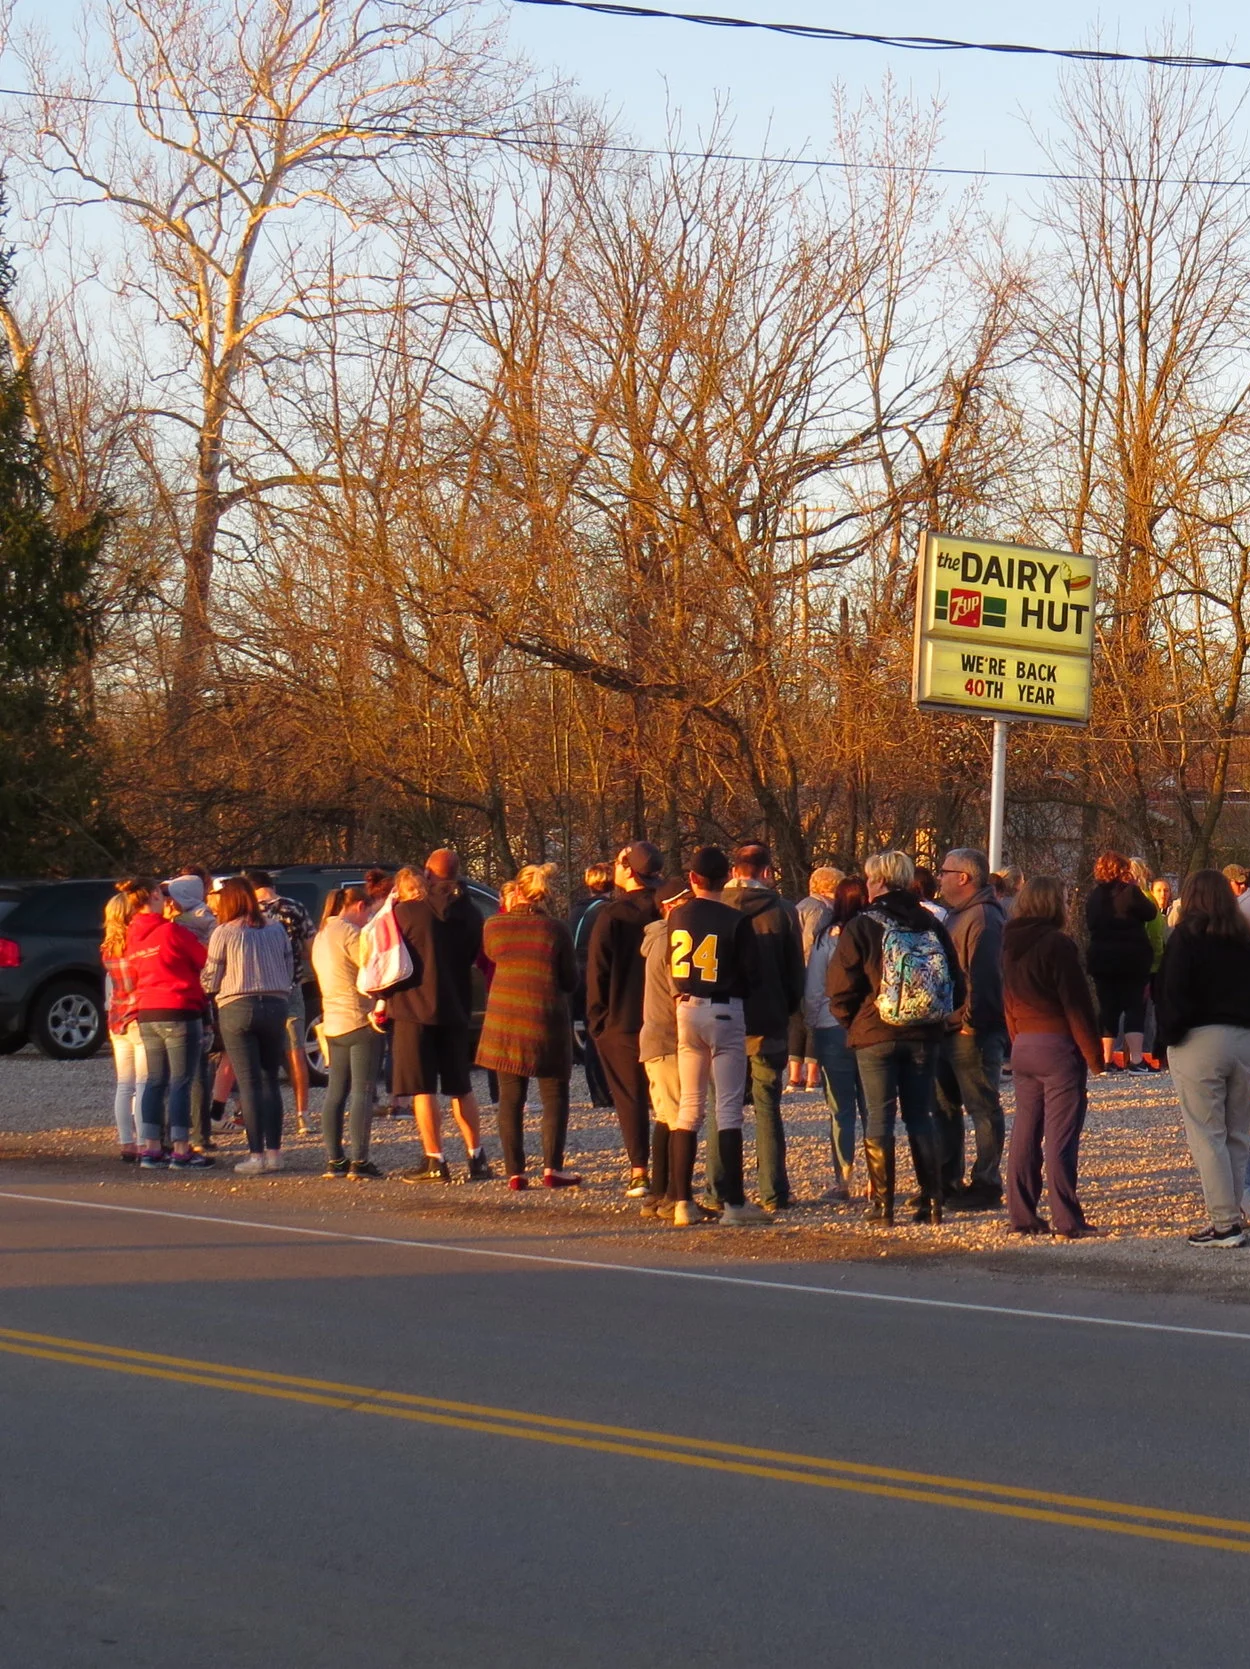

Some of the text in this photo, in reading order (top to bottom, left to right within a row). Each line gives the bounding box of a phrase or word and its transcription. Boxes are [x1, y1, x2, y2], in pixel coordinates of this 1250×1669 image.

[937, 551, 1059, 594] the DAIRY
[1021, 597, 1090, 635] HUT
[961, 653, 1057, 683] WE'RE BACK
[964, 678, 1055, 705] 40TH YEAR
[671, 929, 719, 982] 24
